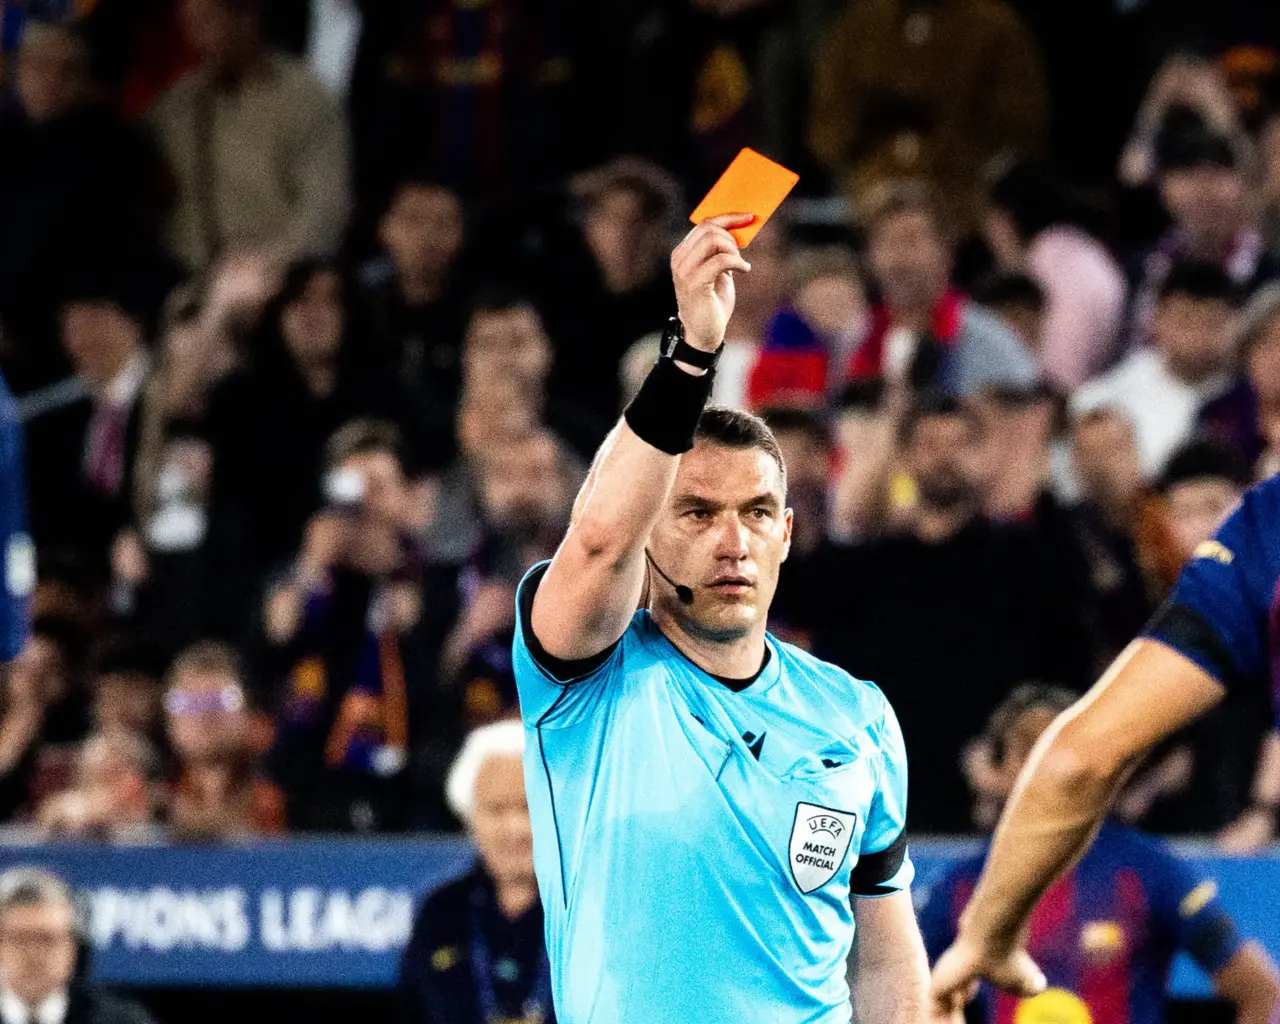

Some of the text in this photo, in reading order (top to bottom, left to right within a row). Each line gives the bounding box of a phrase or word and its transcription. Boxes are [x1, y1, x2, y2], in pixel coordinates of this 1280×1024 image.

[809, 818, 842, 836] UEFA
[803, 842, 836, 856] MATCH
[795, 853, 834, 870] OFFICIAL
